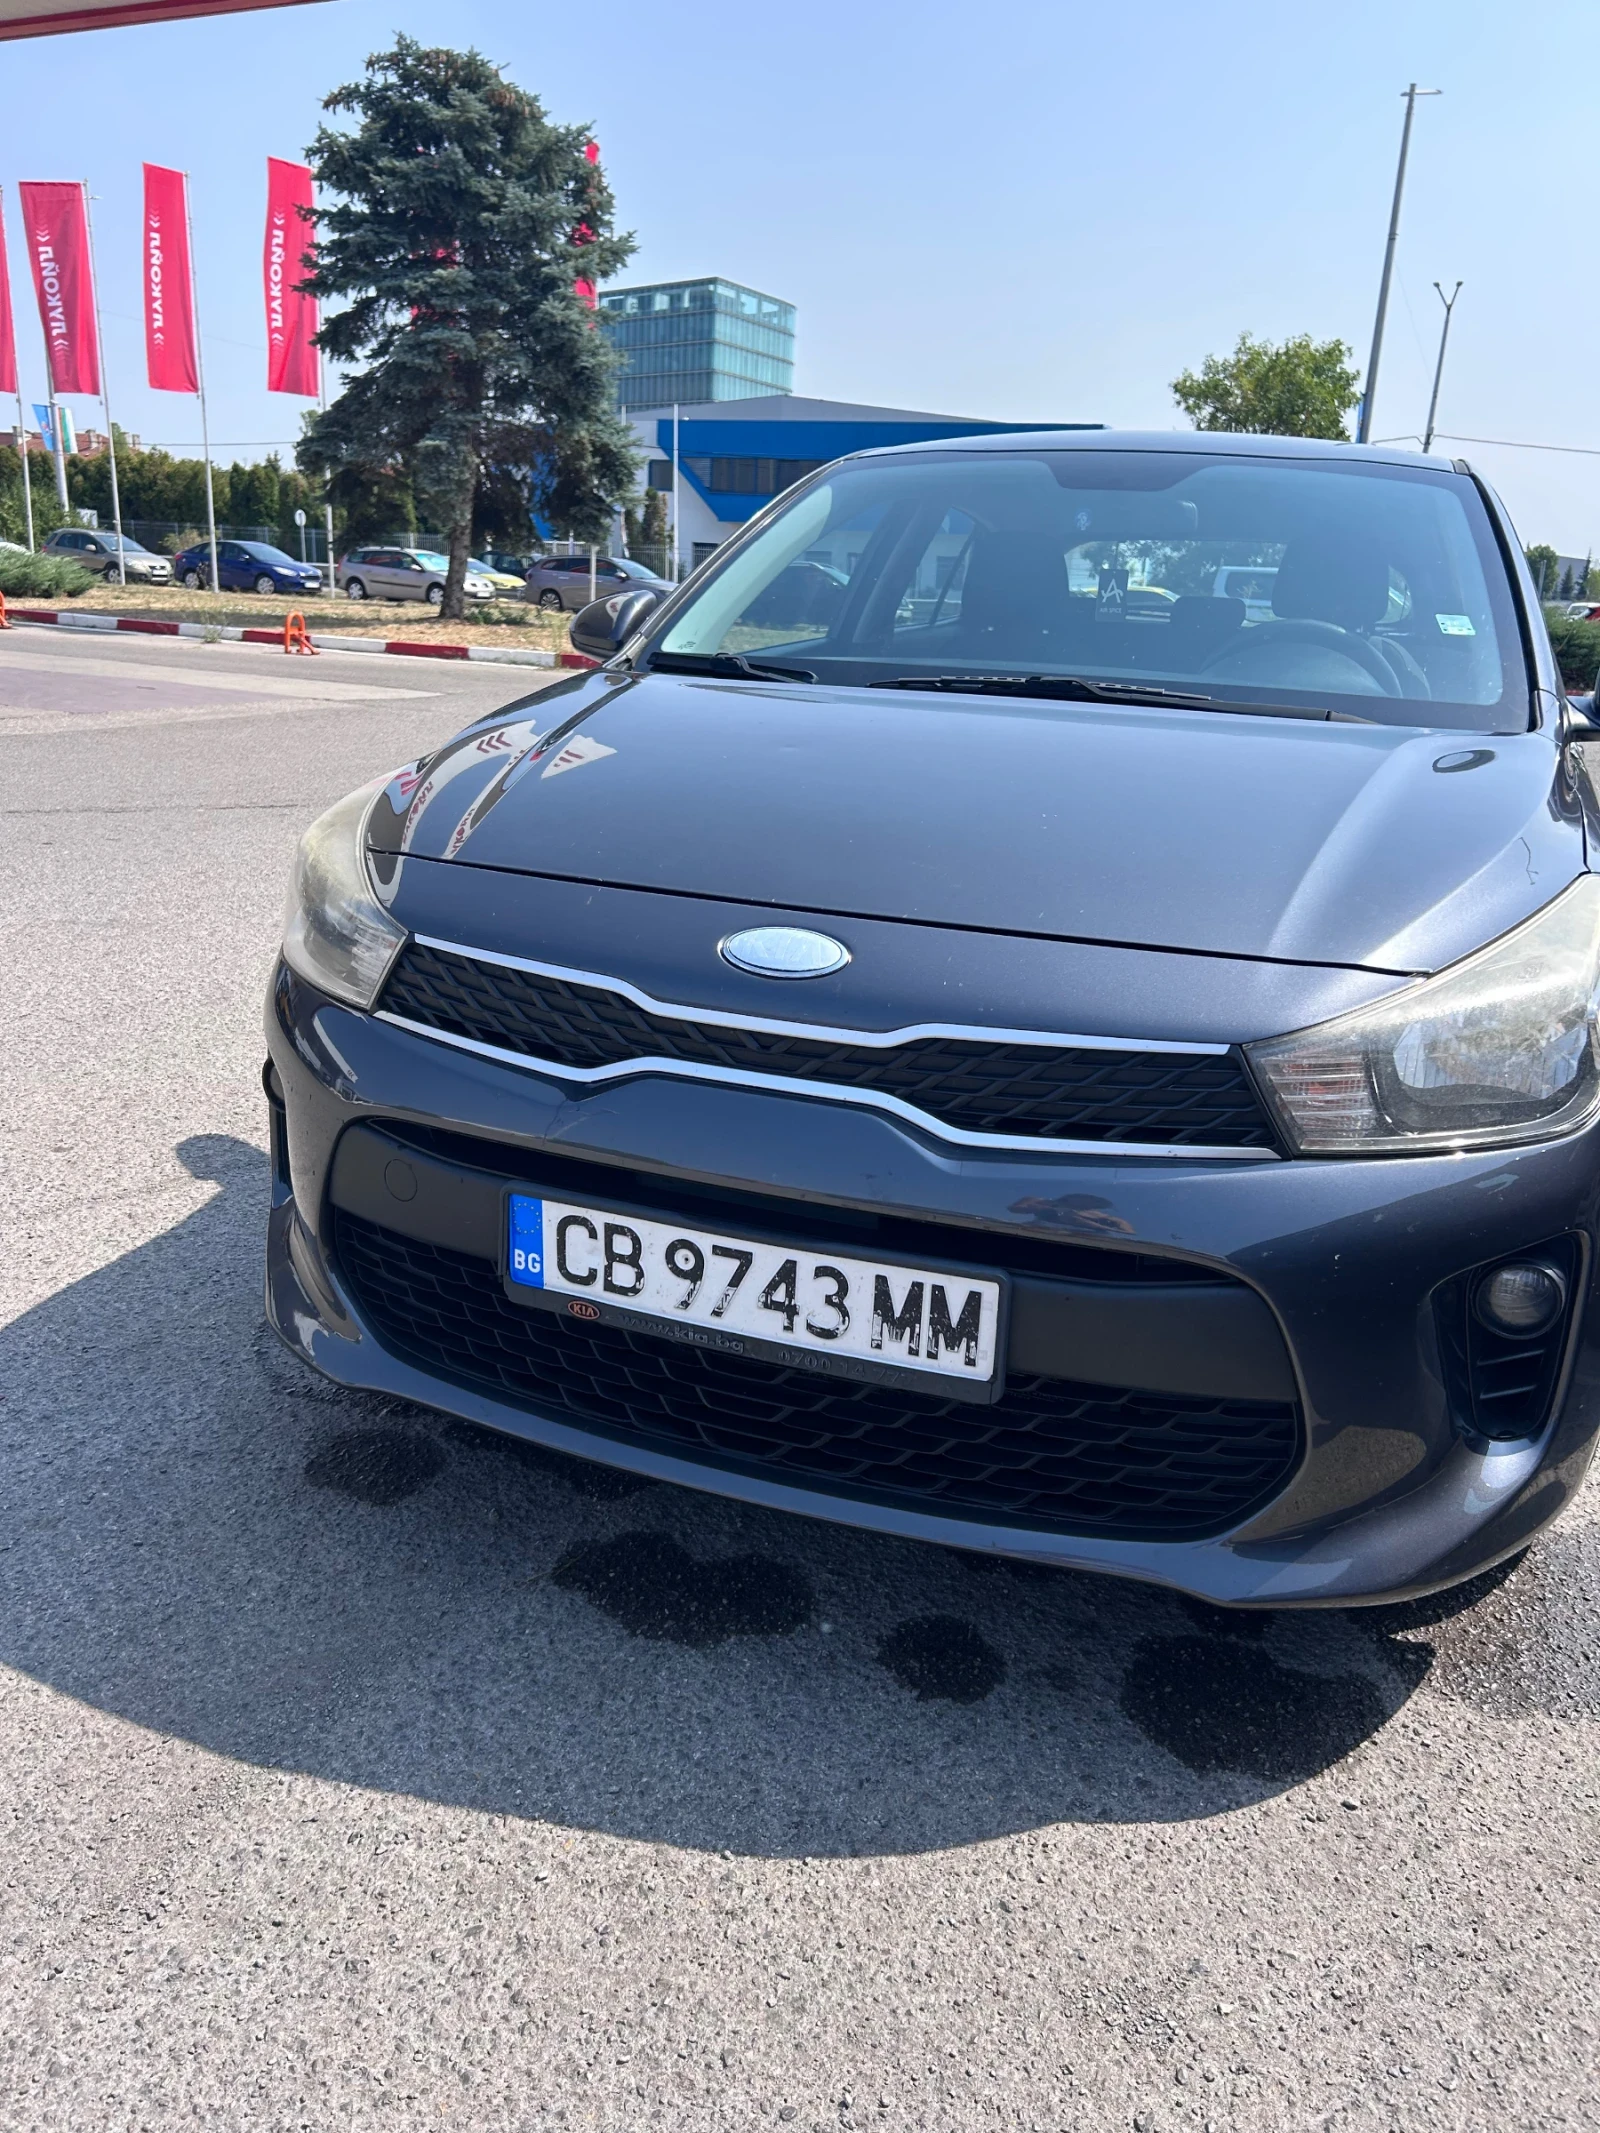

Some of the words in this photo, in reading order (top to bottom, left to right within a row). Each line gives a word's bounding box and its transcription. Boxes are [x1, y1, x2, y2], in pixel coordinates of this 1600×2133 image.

[513, 1249, 541, 1274] BG
[556, 1214, 646, 1298] CB
[664, 1238, 850, 1340] 9743
[870, 1274, 983, 1368] MM
[573, 1303, 595, 1318] KIA
[619, 1312, 744, 1353] www.kia.bg
[778, 1350, 831, 1370] 0700
